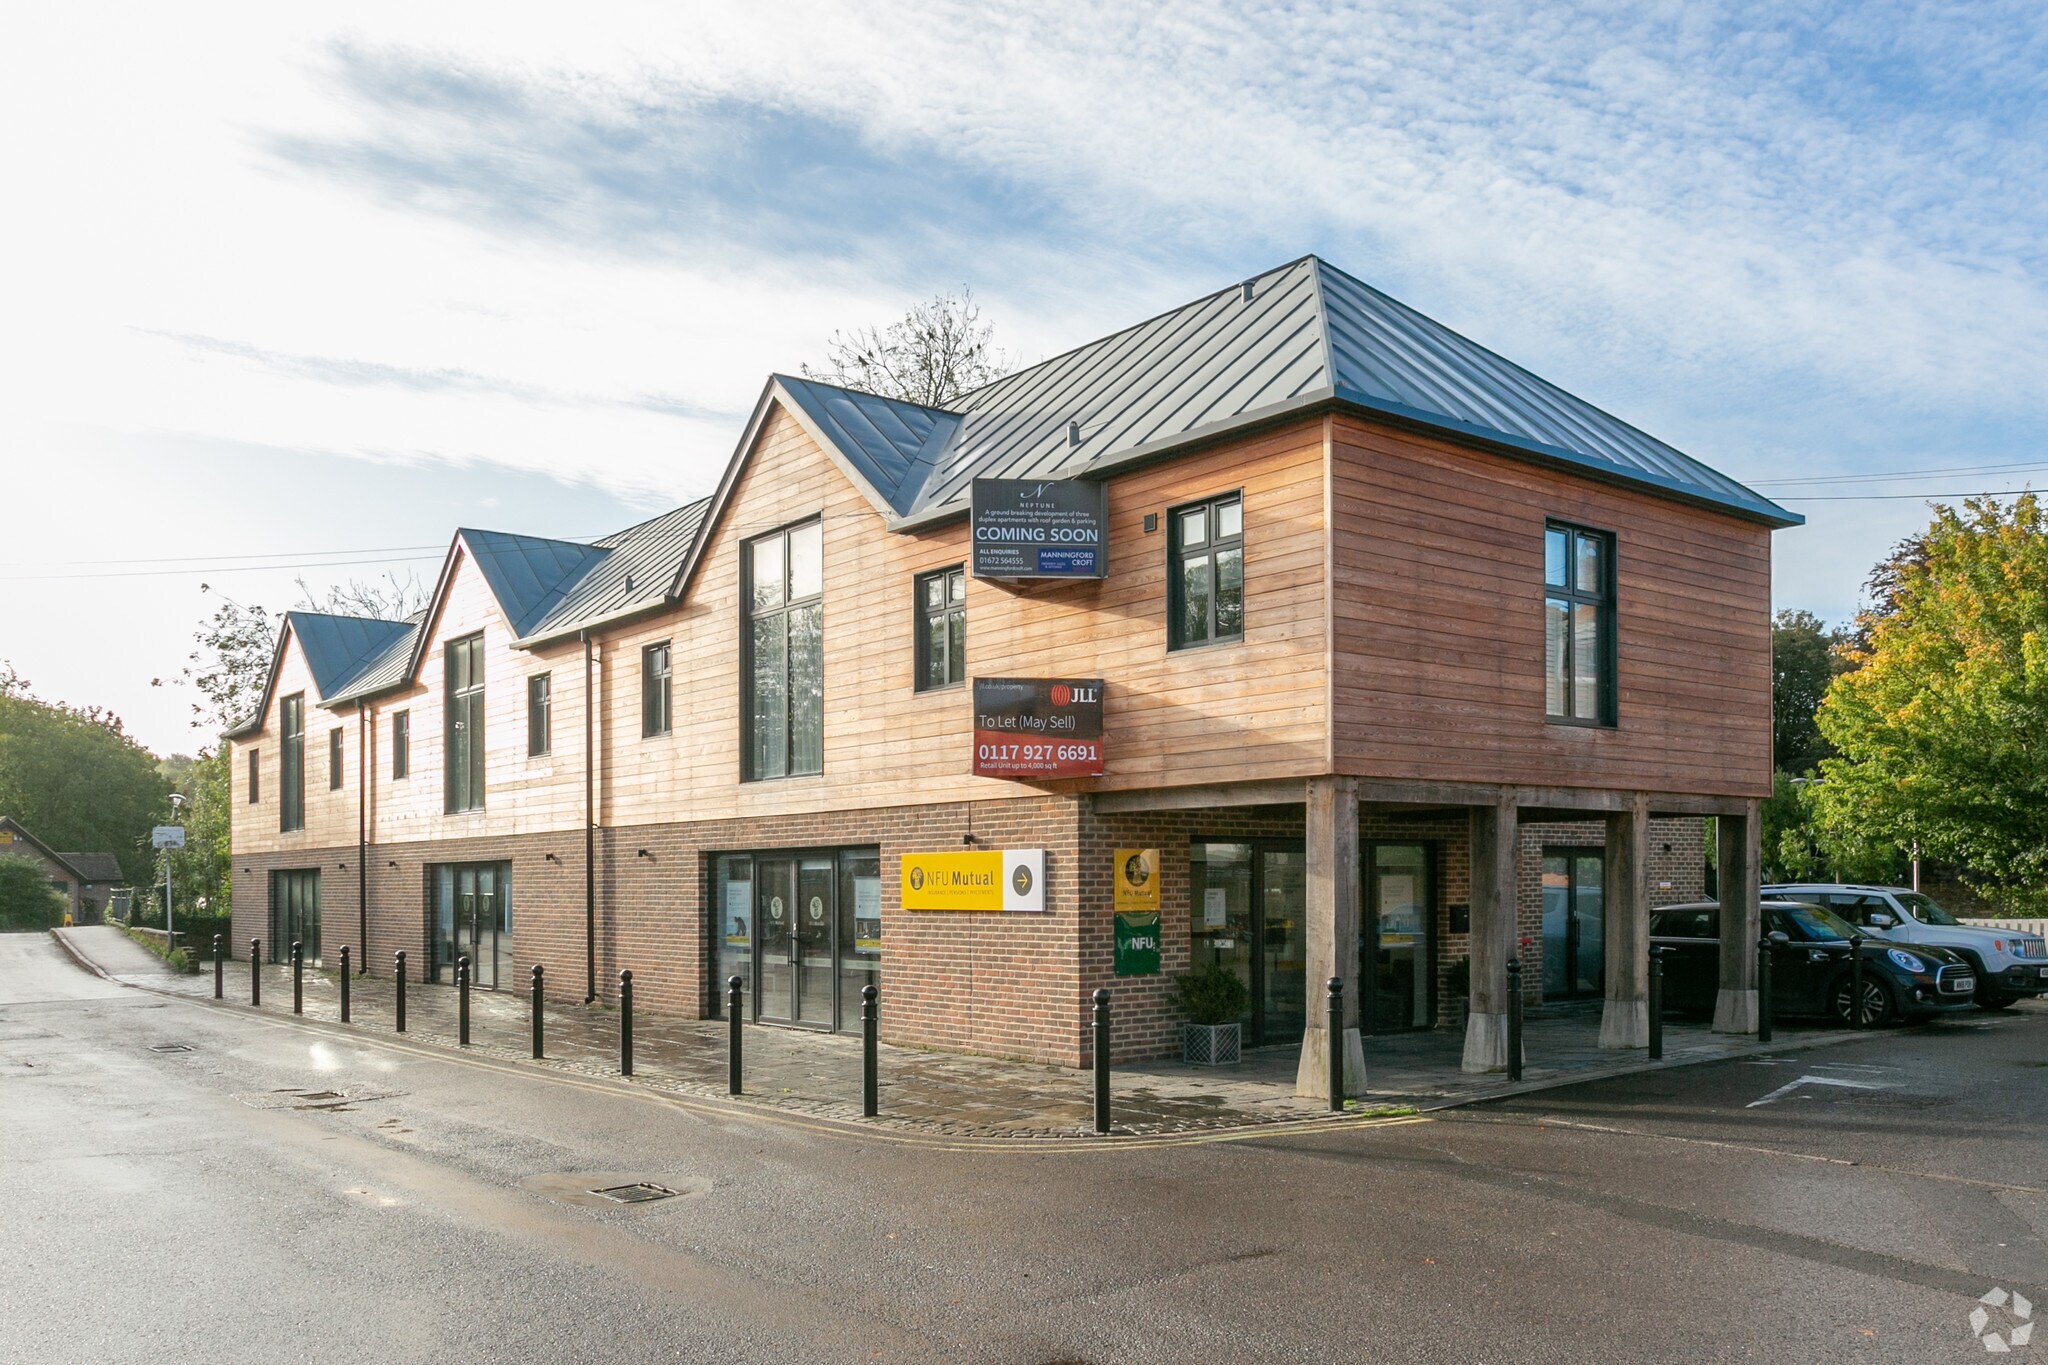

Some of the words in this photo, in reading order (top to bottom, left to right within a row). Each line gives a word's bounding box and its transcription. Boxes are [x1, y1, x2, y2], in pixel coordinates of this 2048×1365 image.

[976, 527, 1044, 541] COMING
[1050, 528, 1098, 542] SOON
[1071, 688, 1096, 702] JLL
[979, 715, 995, 728] To
[998, 715, 1016, 728] Let
[1019, 716, 1047, 731] (May
[1050, 716, 1075, 730] Sell)
[979, 745, 1019, 760] 0117
[1024, 745, 1053, 760] 927
[1058, 745, 1096, 760] 6691
[927, 871, 949, 886] NFU
[952, 870, 994, 886] Mutual
[1132, 937, 1153, 950] NFU
